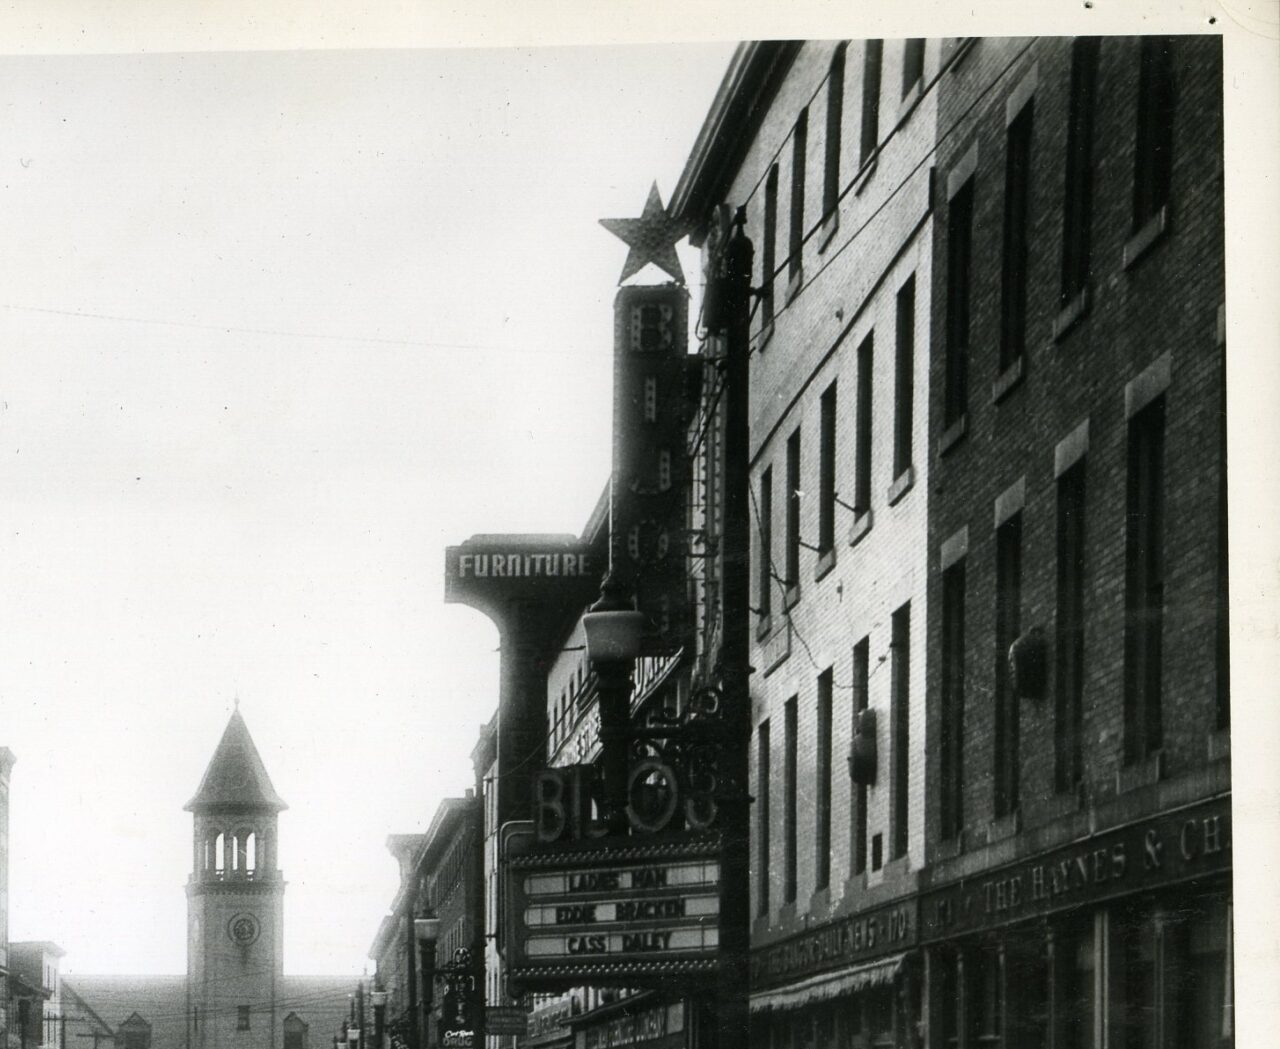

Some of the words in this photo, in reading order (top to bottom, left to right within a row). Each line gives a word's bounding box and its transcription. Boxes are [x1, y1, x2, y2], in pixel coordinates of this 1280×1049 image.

[459, 553, 593, 578] FURNITURE
[1180, 815, 1231, 860] CH
[568, 934, 607, 954] CASS
